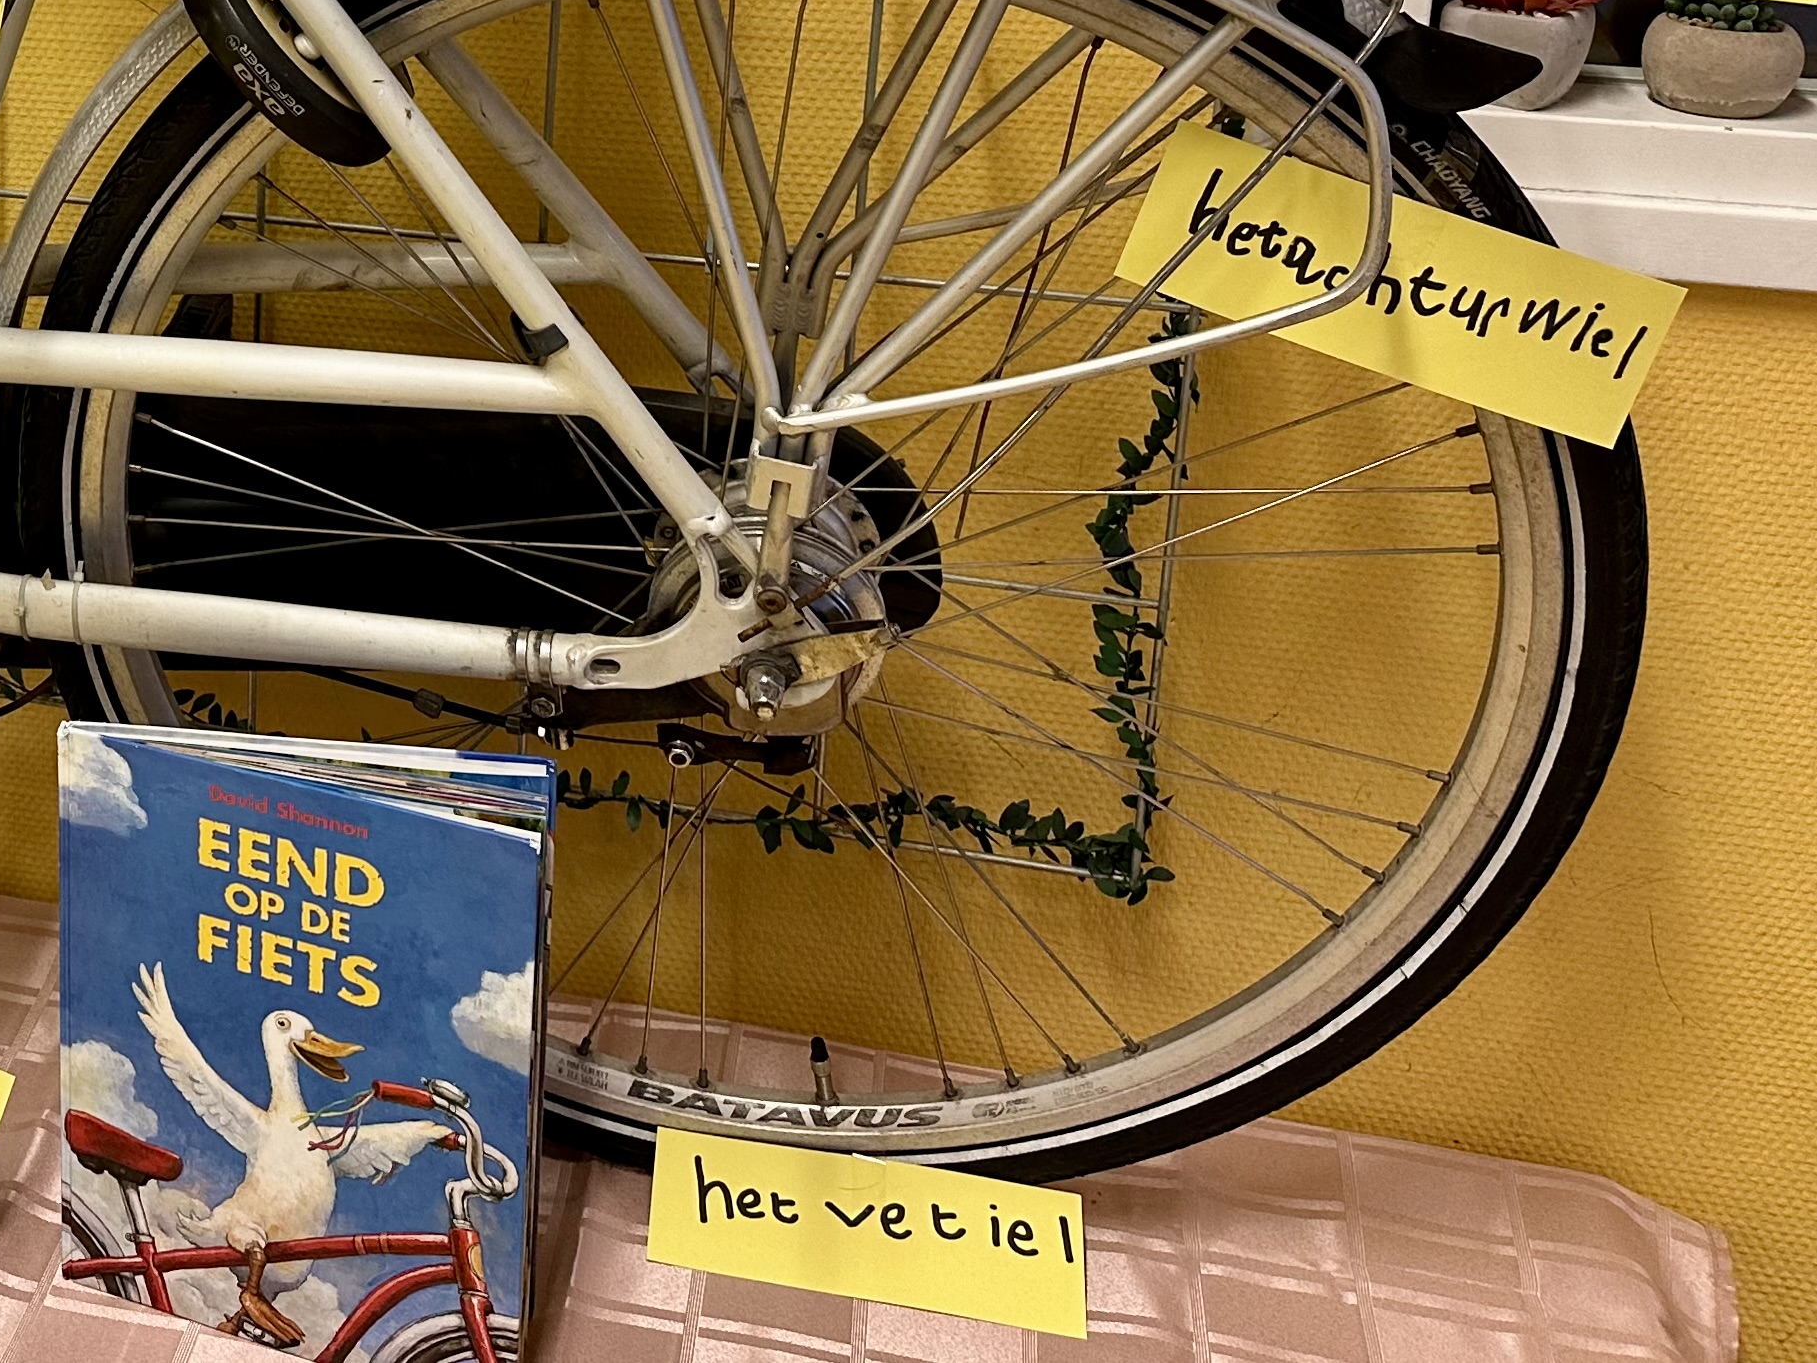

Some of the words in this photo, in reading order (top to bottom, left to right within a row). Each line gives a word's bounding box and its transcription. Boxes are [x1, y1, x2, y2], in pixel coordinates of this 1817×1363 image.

[240, 44, 305, 116] DEFENDER
[209, 785, 269, 814] David
[276, 802, 369, 839] Shannon
[198, 817, 384, 907] EEND
[224, 882, 285, 921] OP
[301, 901, 351, 943] DE
[198, 914, 381, 1007] FIETS
[627, 1078, 943, 1128] BATAVUS
[694, 1154, 799, 1224] het
